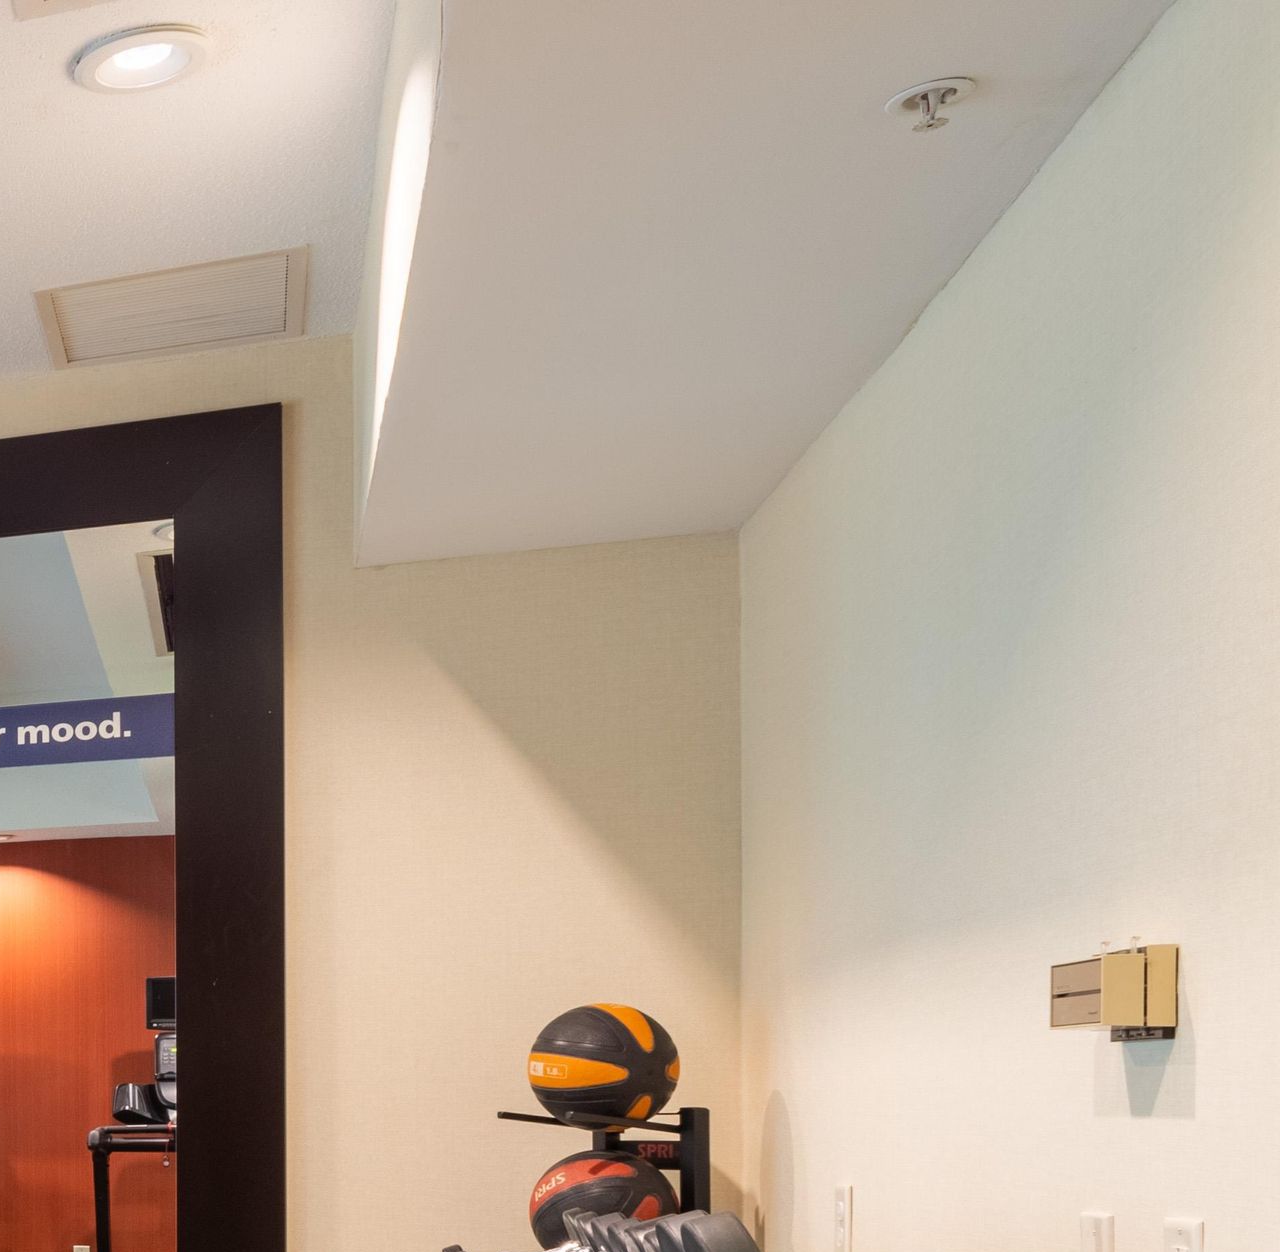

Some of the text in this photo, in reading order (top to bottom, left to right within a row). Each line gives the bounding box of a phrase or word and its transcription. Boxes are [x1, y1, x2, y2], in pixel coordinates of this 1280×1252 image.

[16, 711, 132, 745] mood.
[638, 1143, 673, 1158] SPRI
[534, 1171, 566, 1202] SPRI
